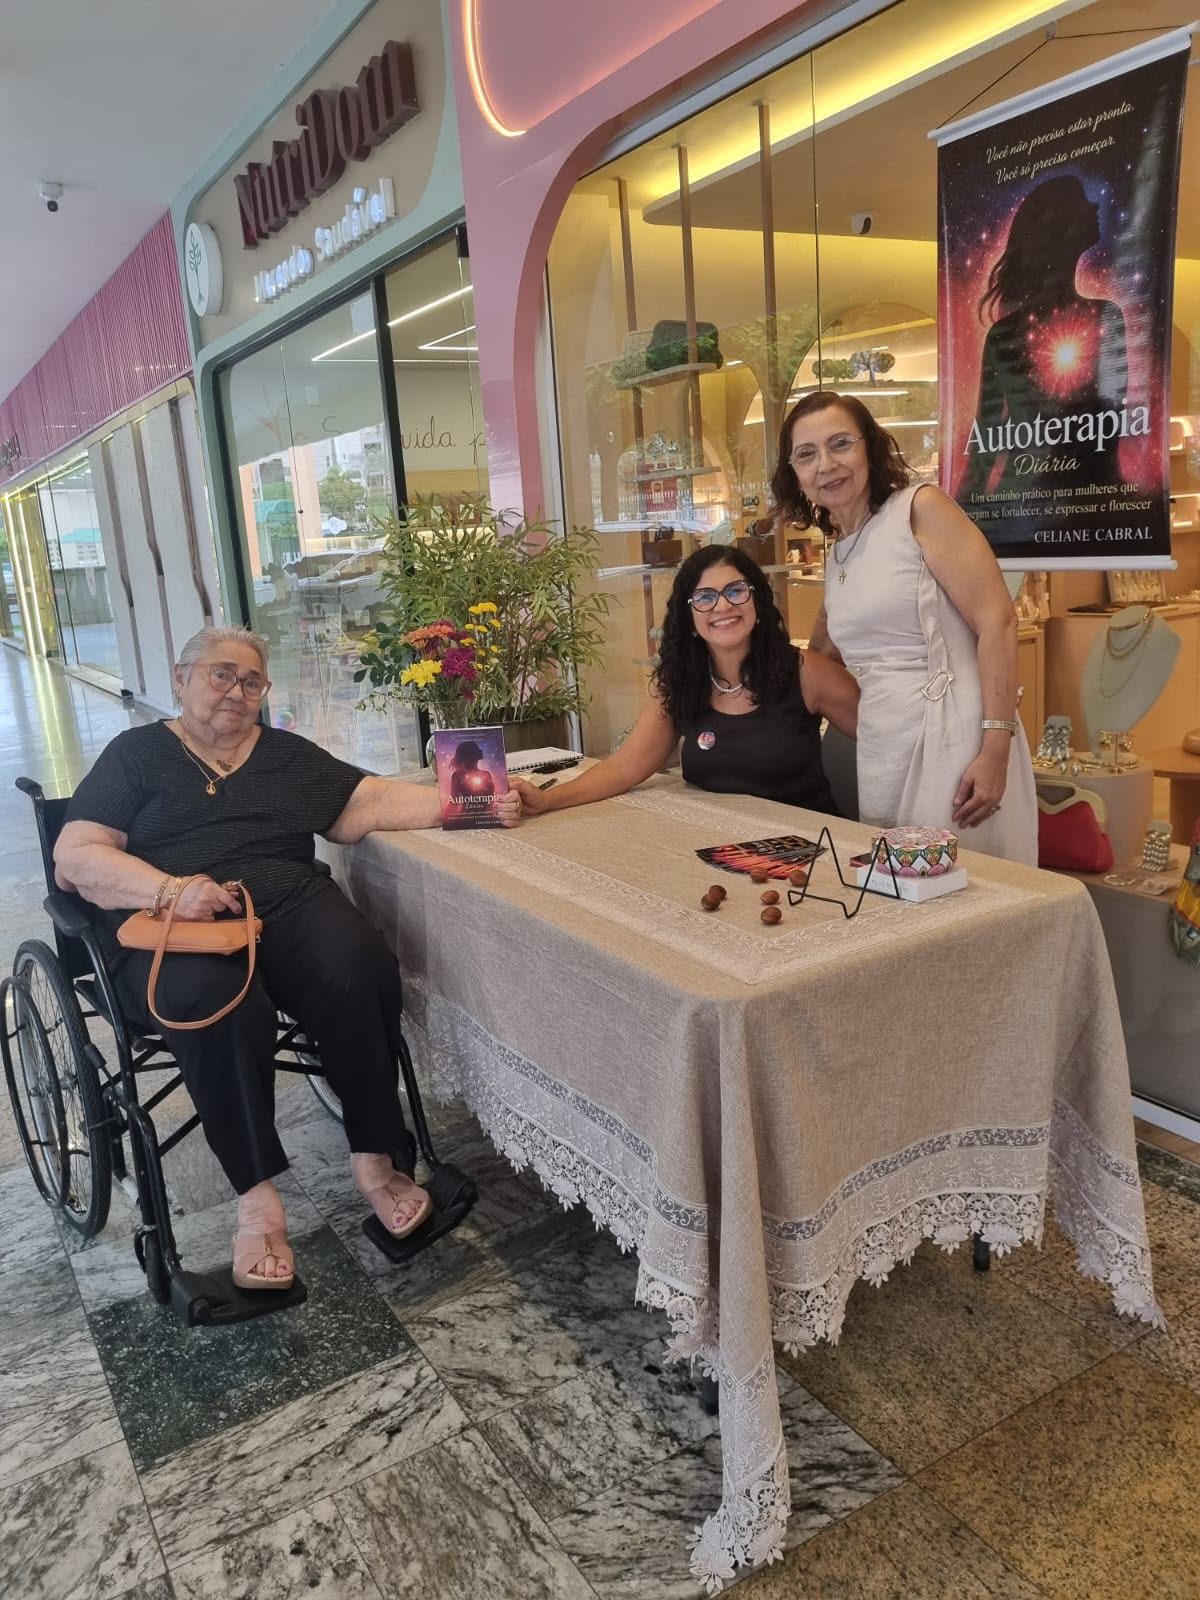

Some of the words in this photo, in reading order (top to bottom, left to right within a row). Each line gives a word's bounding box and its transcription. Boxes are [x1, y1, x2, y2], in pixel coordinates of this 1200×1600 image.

[1010, 141, 1028, 154] não
[1028, 129, 1065, 156] precisa
[1067, 117, 1093, 134] estar
[1092, 101, 1135, 132] pronta.
[1020, 162, 1031, 176] só
[1030, 153, 1067, 179] precisa
[1070, 136, 1116, 159] começar.
[964, 398, 1151, 456] Autoterapia
[1014, 453, 1081, 476] Diária
[971, 493, 985, 503] Um
[986, 489, 1020, 502] caminho
[1022, 487, 1051, 502] prático
[1053, 488, 1073, 500] para
[1075, 483, 1118, 496] mulheres
[1120, 483, 1140, 495] que
[1001, 507, 1042, 518] fortalecer,
[1044, 507, 1053, 515] se
[1055, 503, 1098, 517] expressar
[1109, 499, 1152, 512] florescer
[1034, 529, 1090, 543] CELIANE
[1095, 527, 1153, 541] CABRAL
